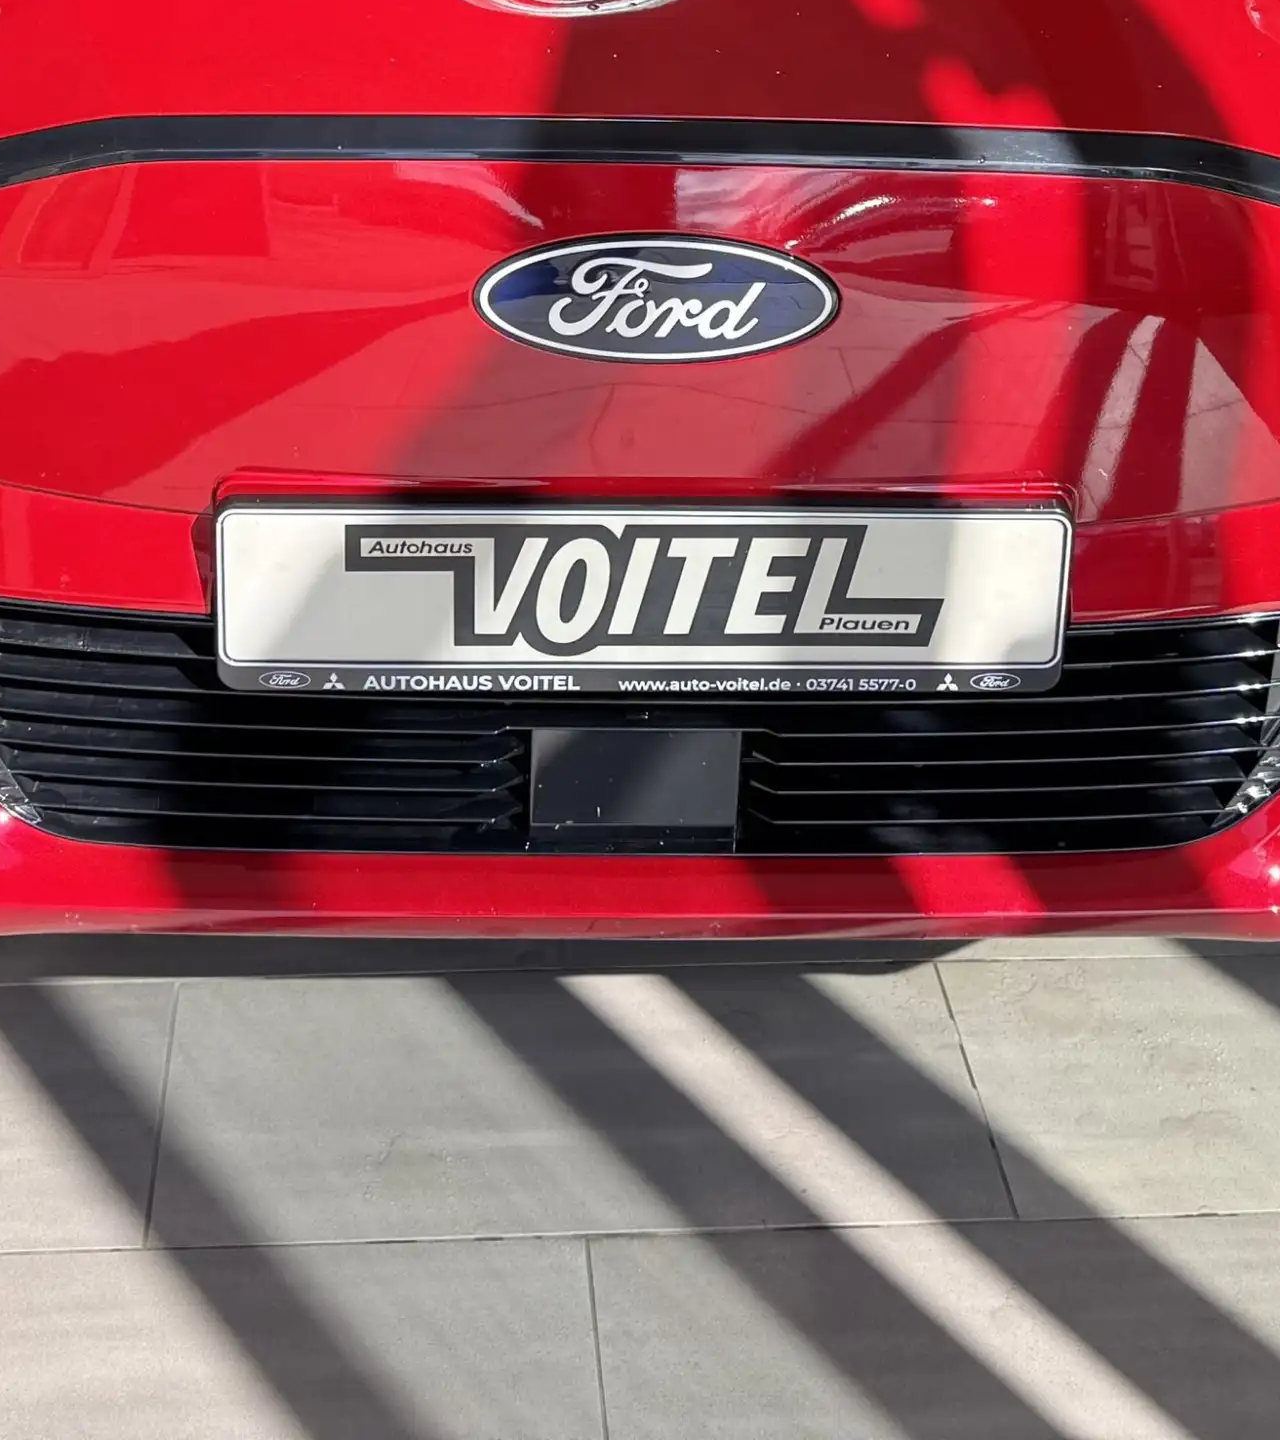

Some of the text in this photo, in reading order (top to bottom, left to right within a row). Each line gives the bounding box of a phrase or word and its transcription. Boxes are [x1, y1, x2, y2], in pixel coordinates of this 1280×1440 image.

[547, 257, 769, 341] Ford
[367, 539, 474, 556] Autohaus
[474, 537, 849, 645] VOITEL
[818, 615, 911, 633] Plauen
[268, 672, 302, 687] Ford
[362, 674, 581, 692] AUTOHAUS VOITEL
[617, 676, 917, 693] www.auto-voitel.de 03741 5577-0
[978, 674, 1011, 689] Ford
